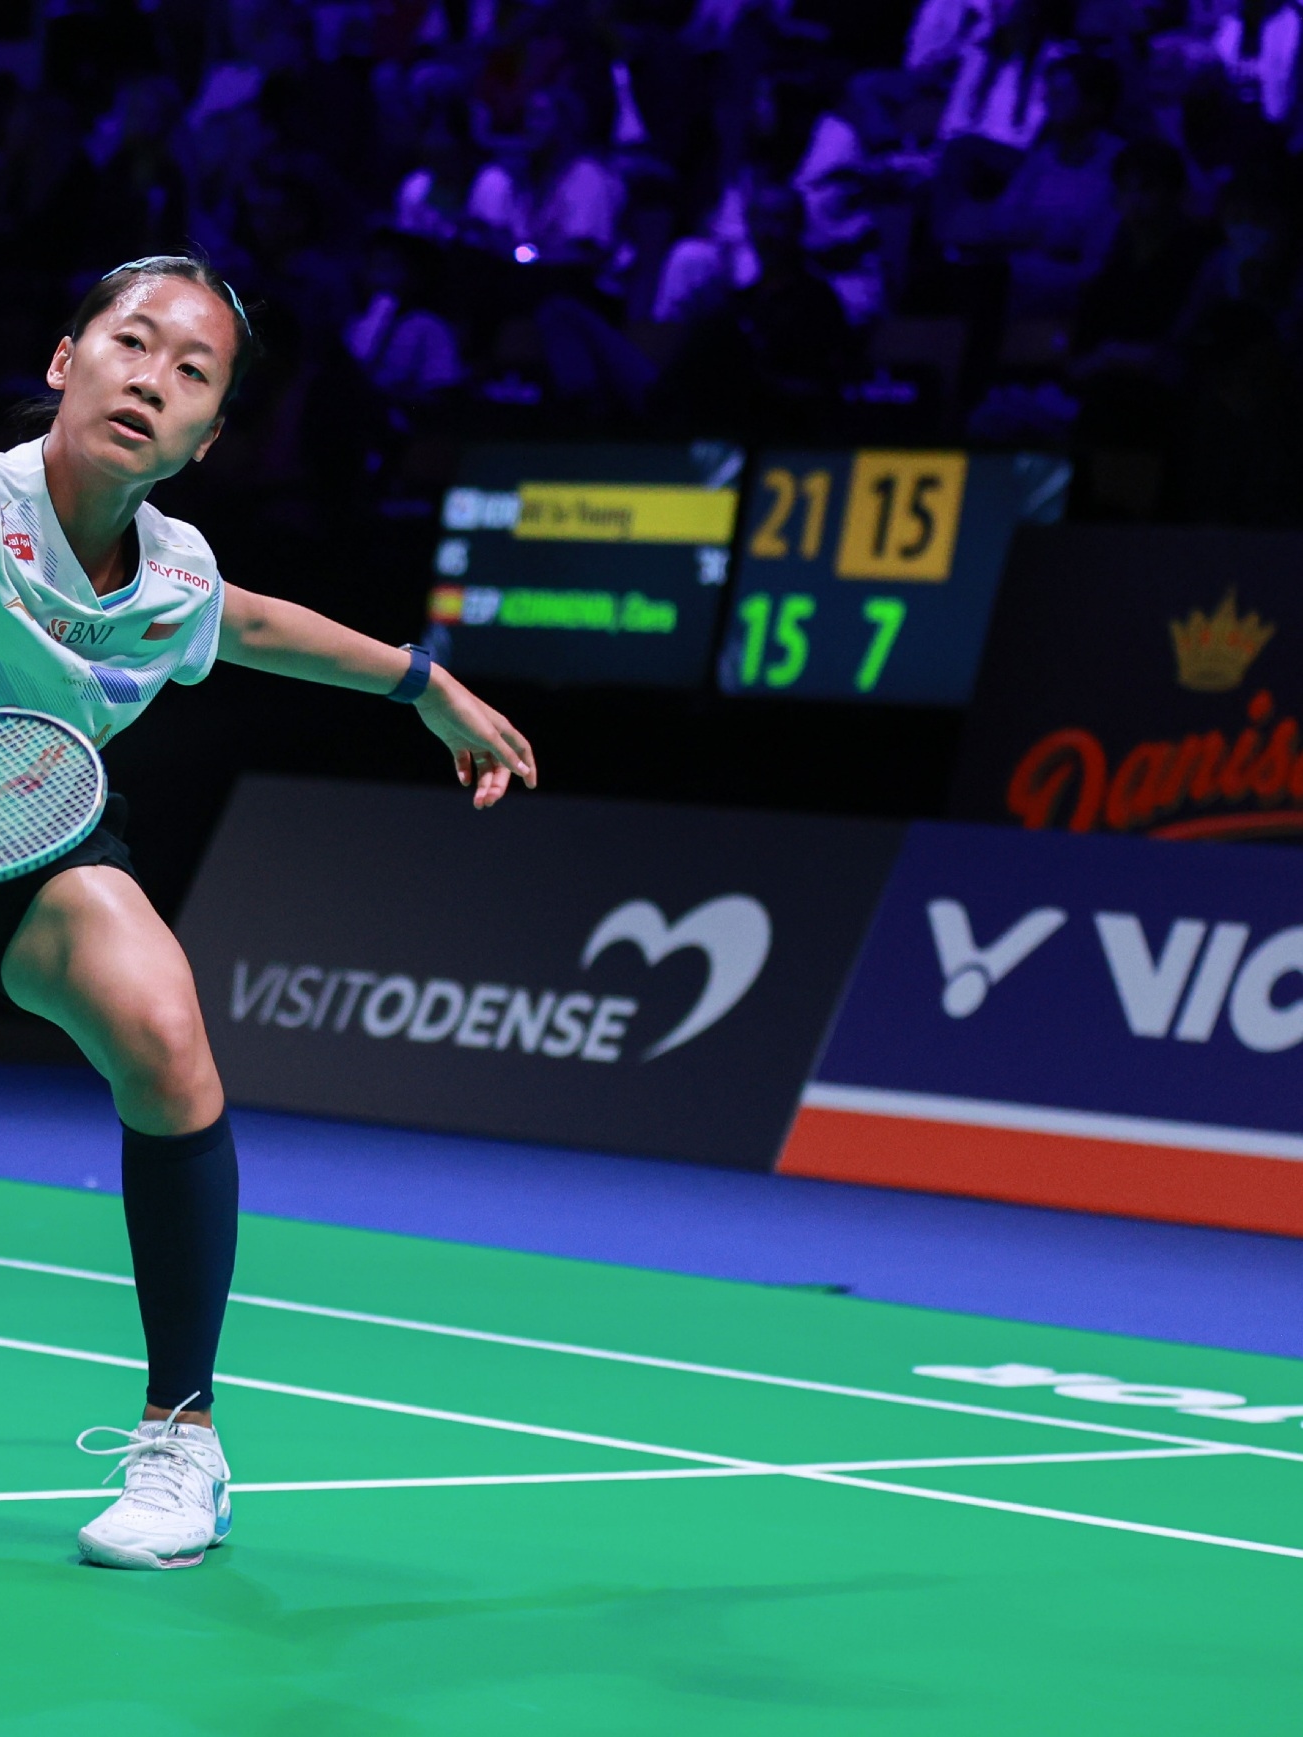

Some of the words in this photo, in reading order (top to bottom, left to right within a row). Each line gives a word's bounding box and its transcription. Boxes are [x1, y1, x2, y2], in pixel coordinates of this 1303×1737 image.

[750, 467, 831, 561] 21
[870, 474, 942, 563] 15
[146, 559, 210, 592] OLYTRON
[65, 621, 116, 646] BNI
[738, 591, 817, 688] 15
[854, 595, 907, 693] 7
[230, 958, 638, 1064] VISITODENSE
